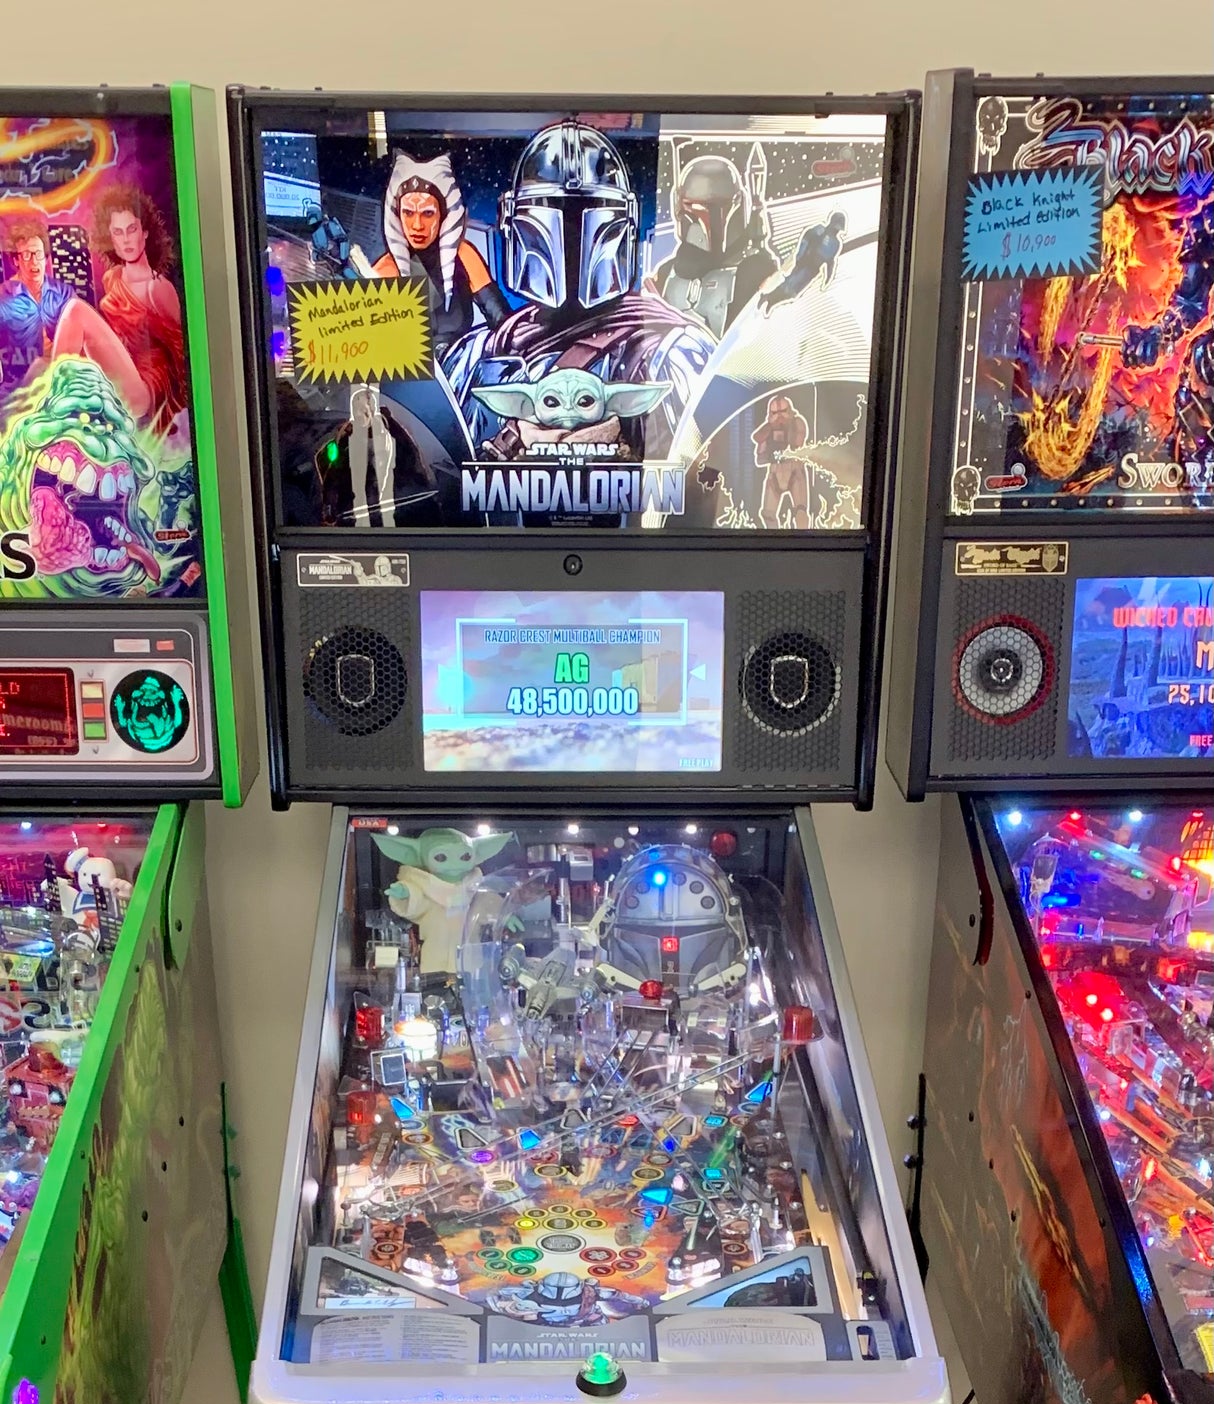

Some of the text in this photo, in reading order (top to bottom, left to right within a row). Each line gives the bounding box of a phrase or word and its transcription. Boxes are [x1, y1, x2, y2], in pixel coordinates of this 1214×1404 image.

[981, 191, 1077, 217] Black Knight
[977, 212, 1031, 234] Limited
[308, 297, 383, 322] Mandalorian
[526, 442, 619, 456] STAR WARS
[559, 458, 584, 466] THE
[461, 469, 685, 515] MANDALORIAN
[484, 629, 661, 644] RAZOR CREST MULTIBALL CHAMPION
[554, 652, 590, 684] AG
[506, 686, 640, 718] 48,500,000
[490, 1341, 647, 1360] MANDALORIAN
